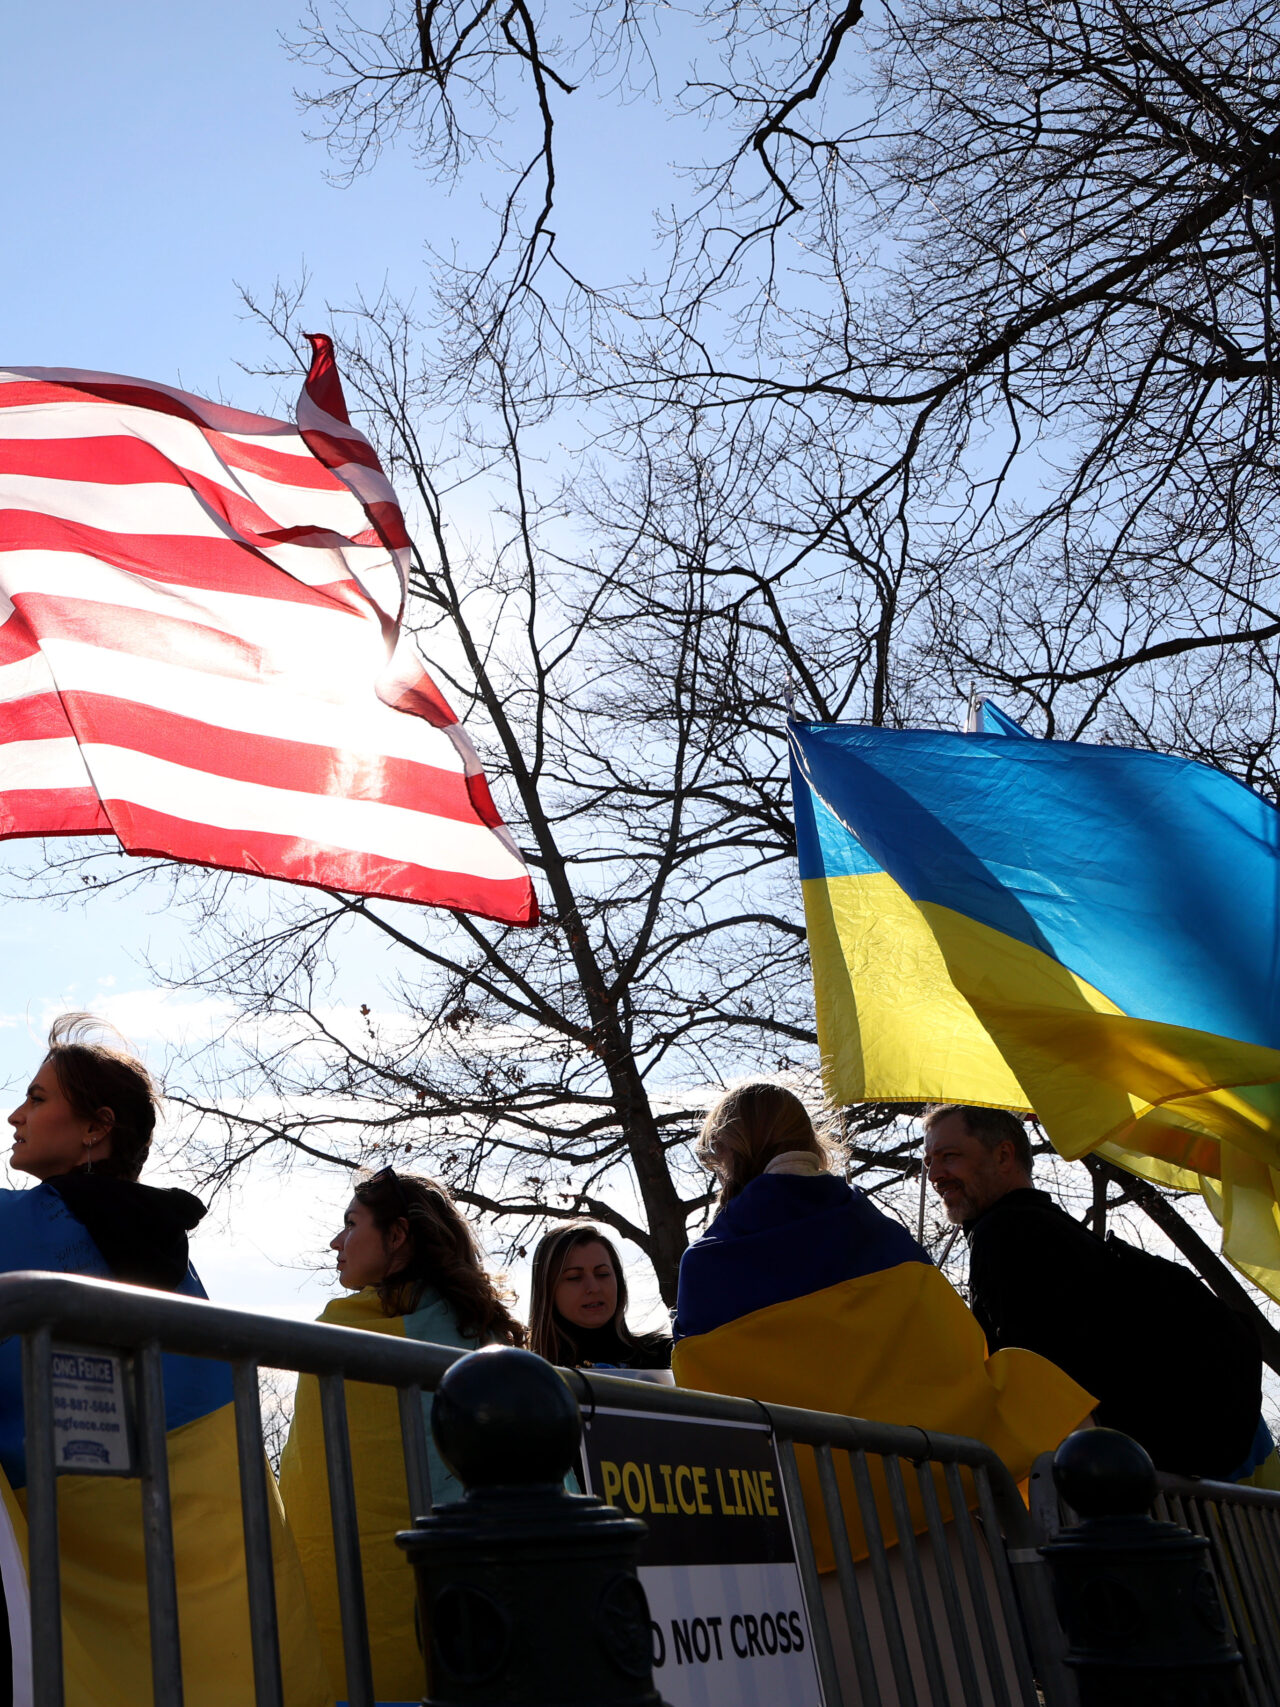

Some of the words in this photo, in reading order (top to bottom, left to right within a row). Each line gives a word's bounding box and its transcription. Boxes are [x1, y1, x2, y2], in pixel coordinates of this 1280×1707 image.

[52, 1357, 77, 1377] ONG
[78, 1357, 112, 1381] FENCE
[53, 1417, 120, 1433] ngfence.com
[600, 1460, 713, 1516] POLICE
[715, 1467, 780, 1517] LINE
[671, 1617, 723, 1665] NOT
[730, 1610, 804, 1659] CROSS
